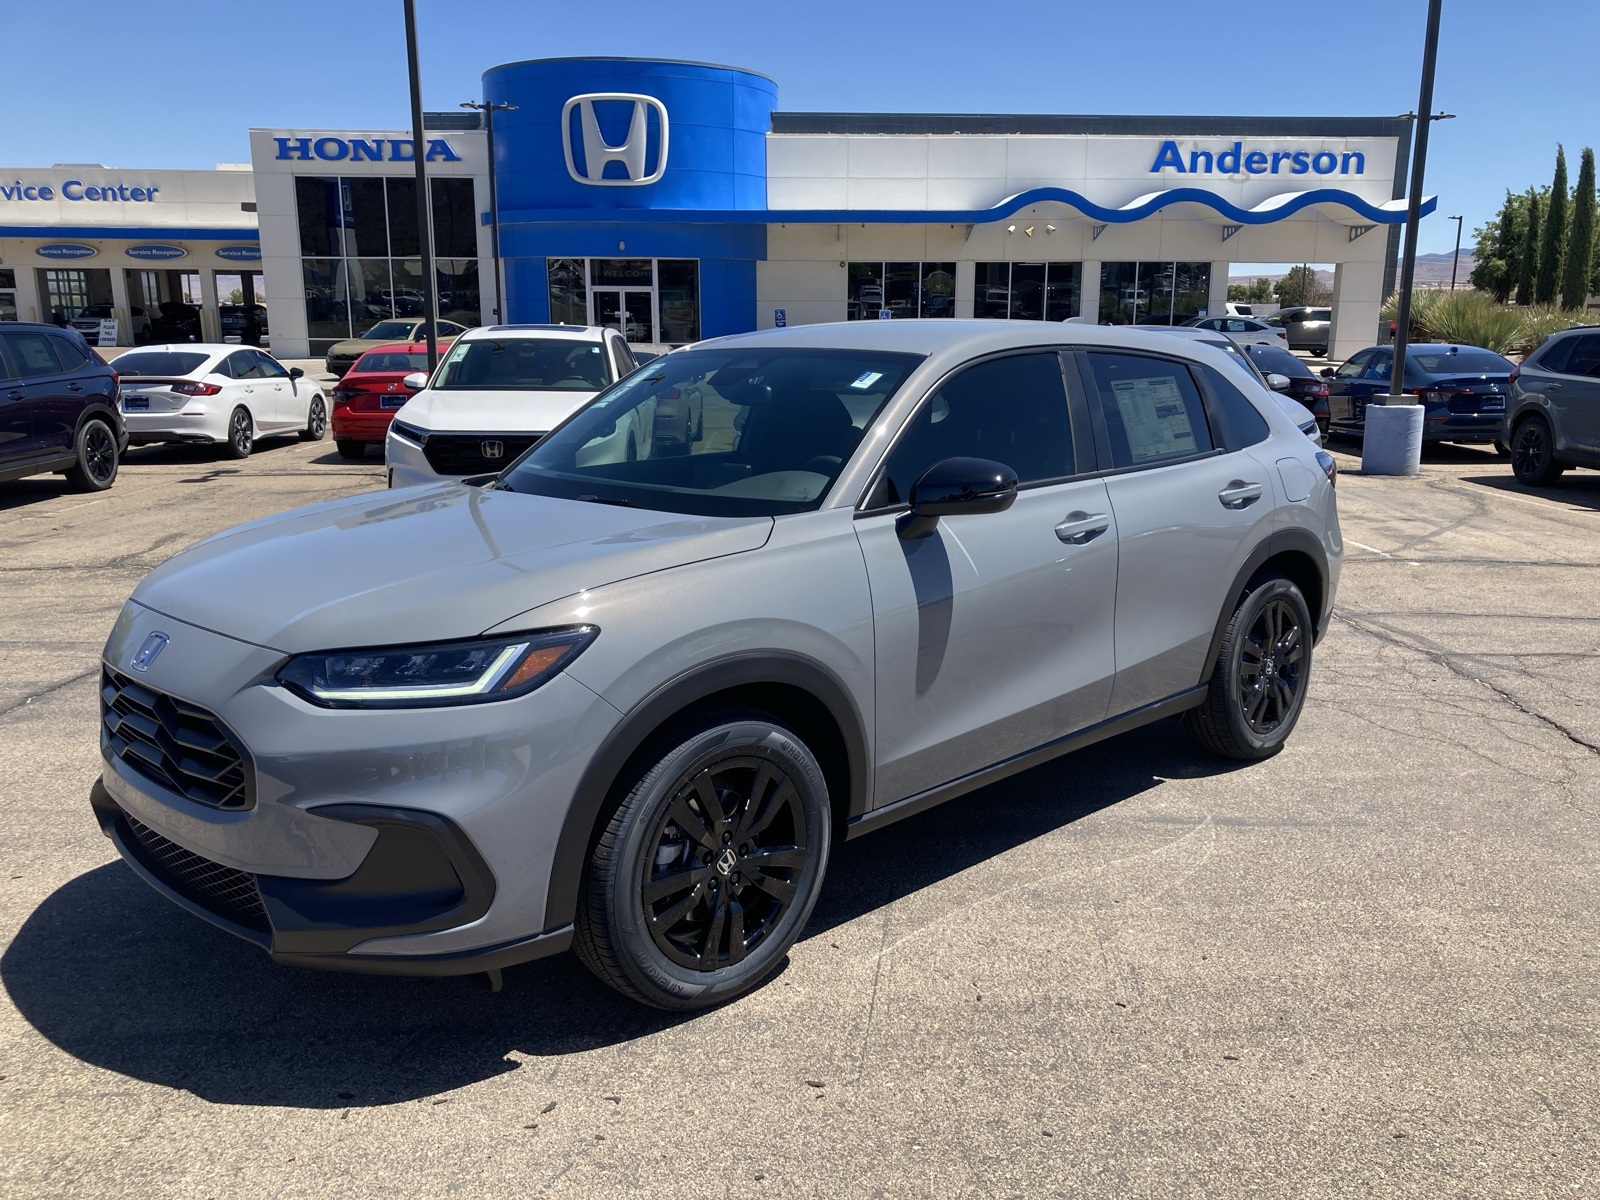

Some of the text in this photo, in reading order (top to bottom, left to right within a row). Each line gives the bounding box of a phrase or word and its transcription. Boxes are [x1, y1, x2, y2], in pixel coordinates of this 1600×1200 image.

[273, 137, 462, 162] HONDA
[1149, 140, 1366, 175] Anderson
[61, 180, 160, 202] Center
[62, 248, 93, 256] Reception
[152, 249, 183, 257] Reception
